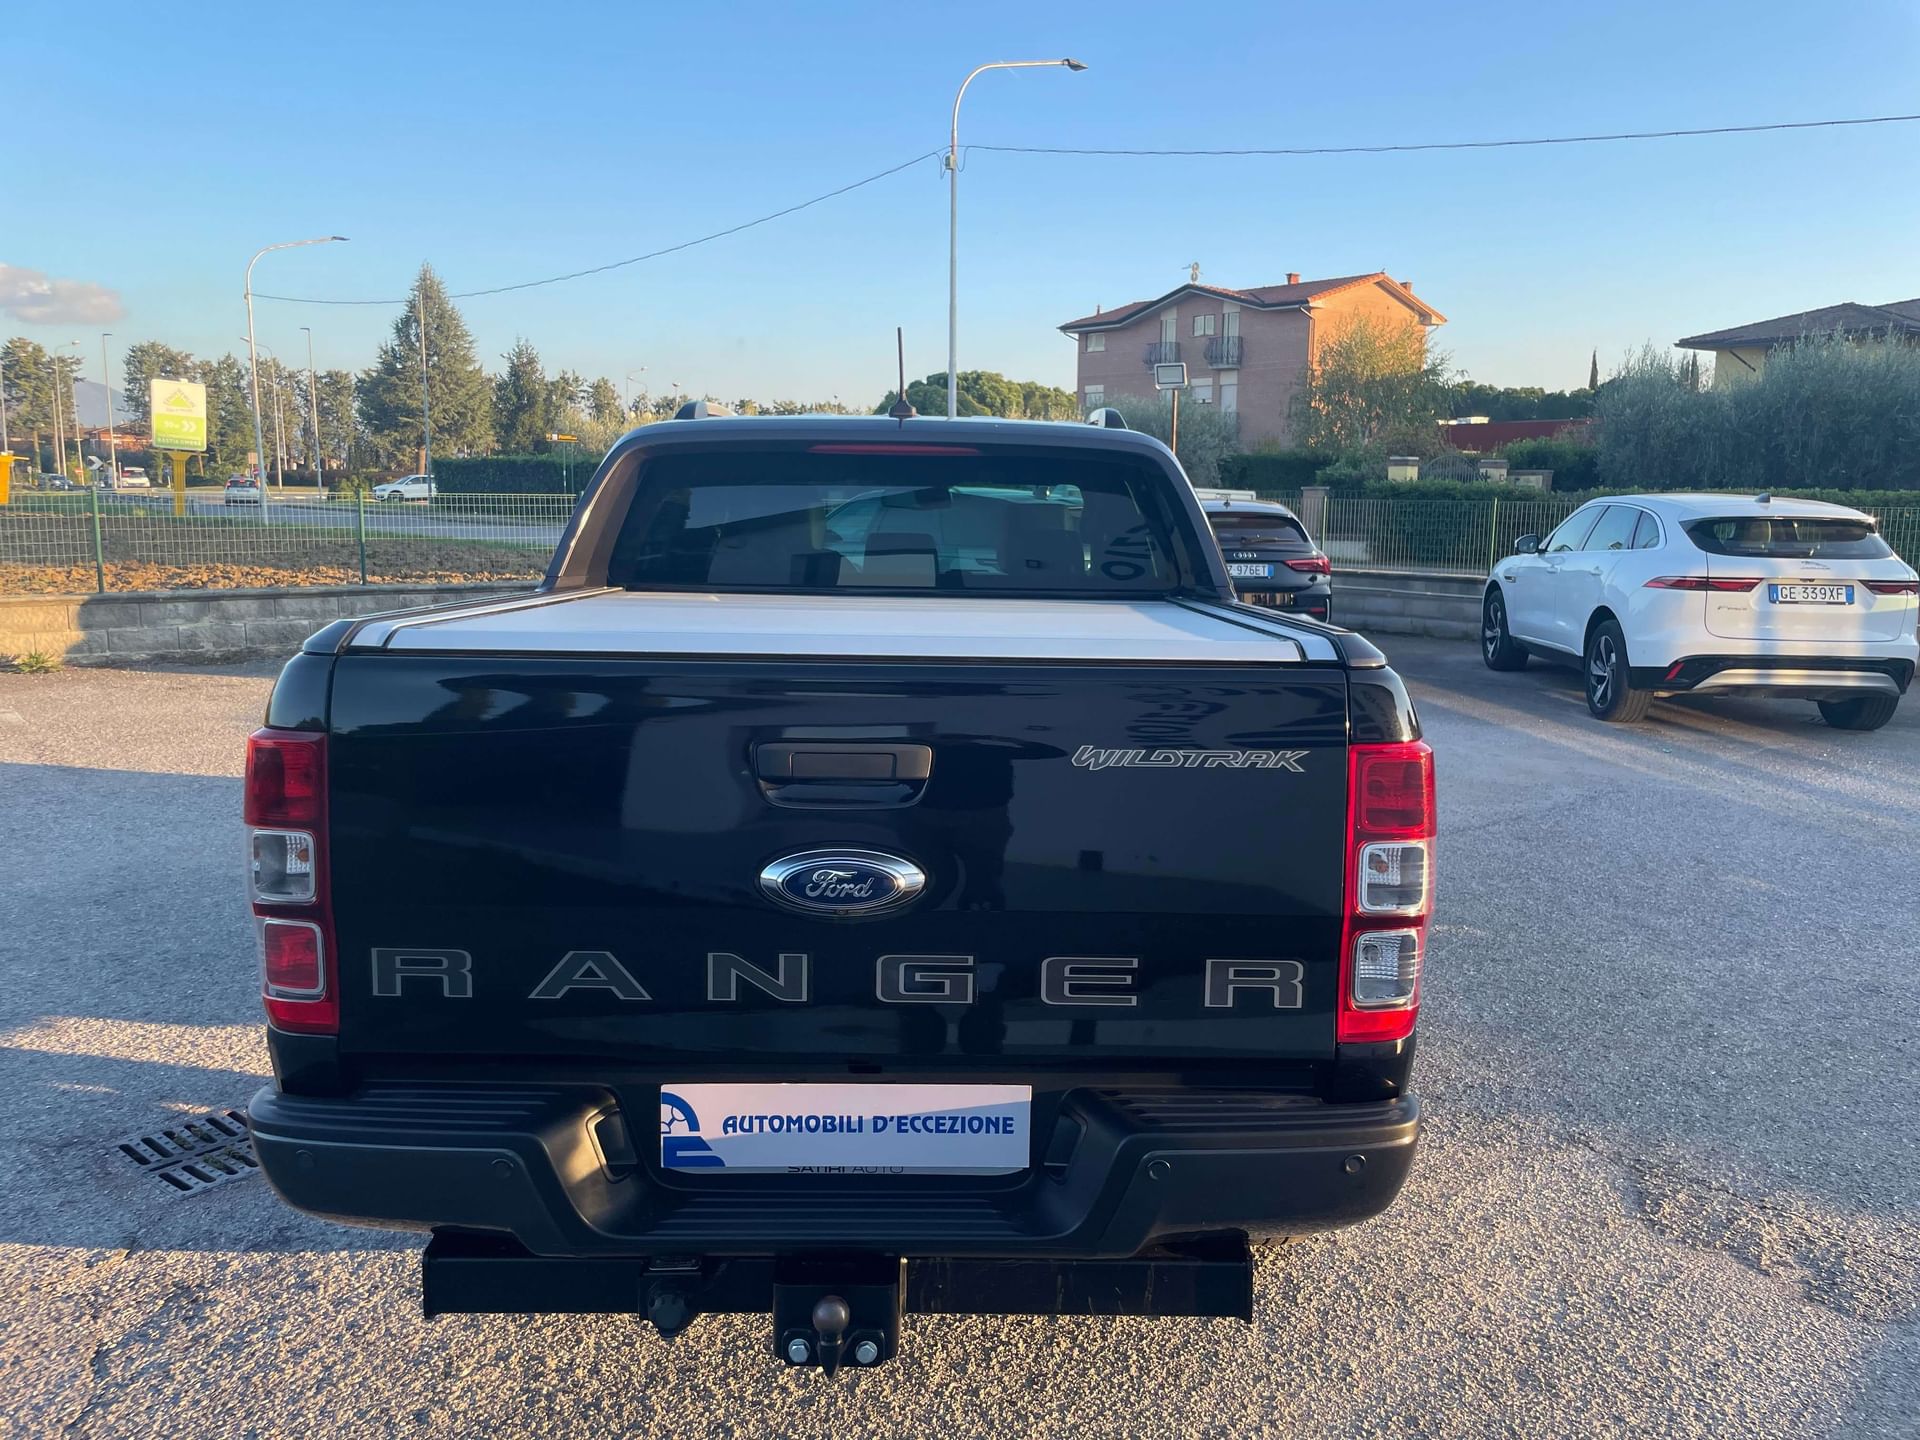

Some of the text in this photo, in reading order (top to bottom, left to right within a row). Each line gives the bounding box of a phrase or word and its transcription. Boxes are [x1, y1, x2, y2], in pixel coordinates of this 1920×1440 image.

[1237, 565, 1266, 576] 976ET
[1780, 587, 1844, 600] GE 339XF
[1071, 745, 1311, 772] WILDTRAK
[805, 869, 874, 898] Ford
[371, 947, 1304, 1009] RANGER
[722, 1115, 1015, 1135] AUTOMOBILI D'ECCEZIONE
